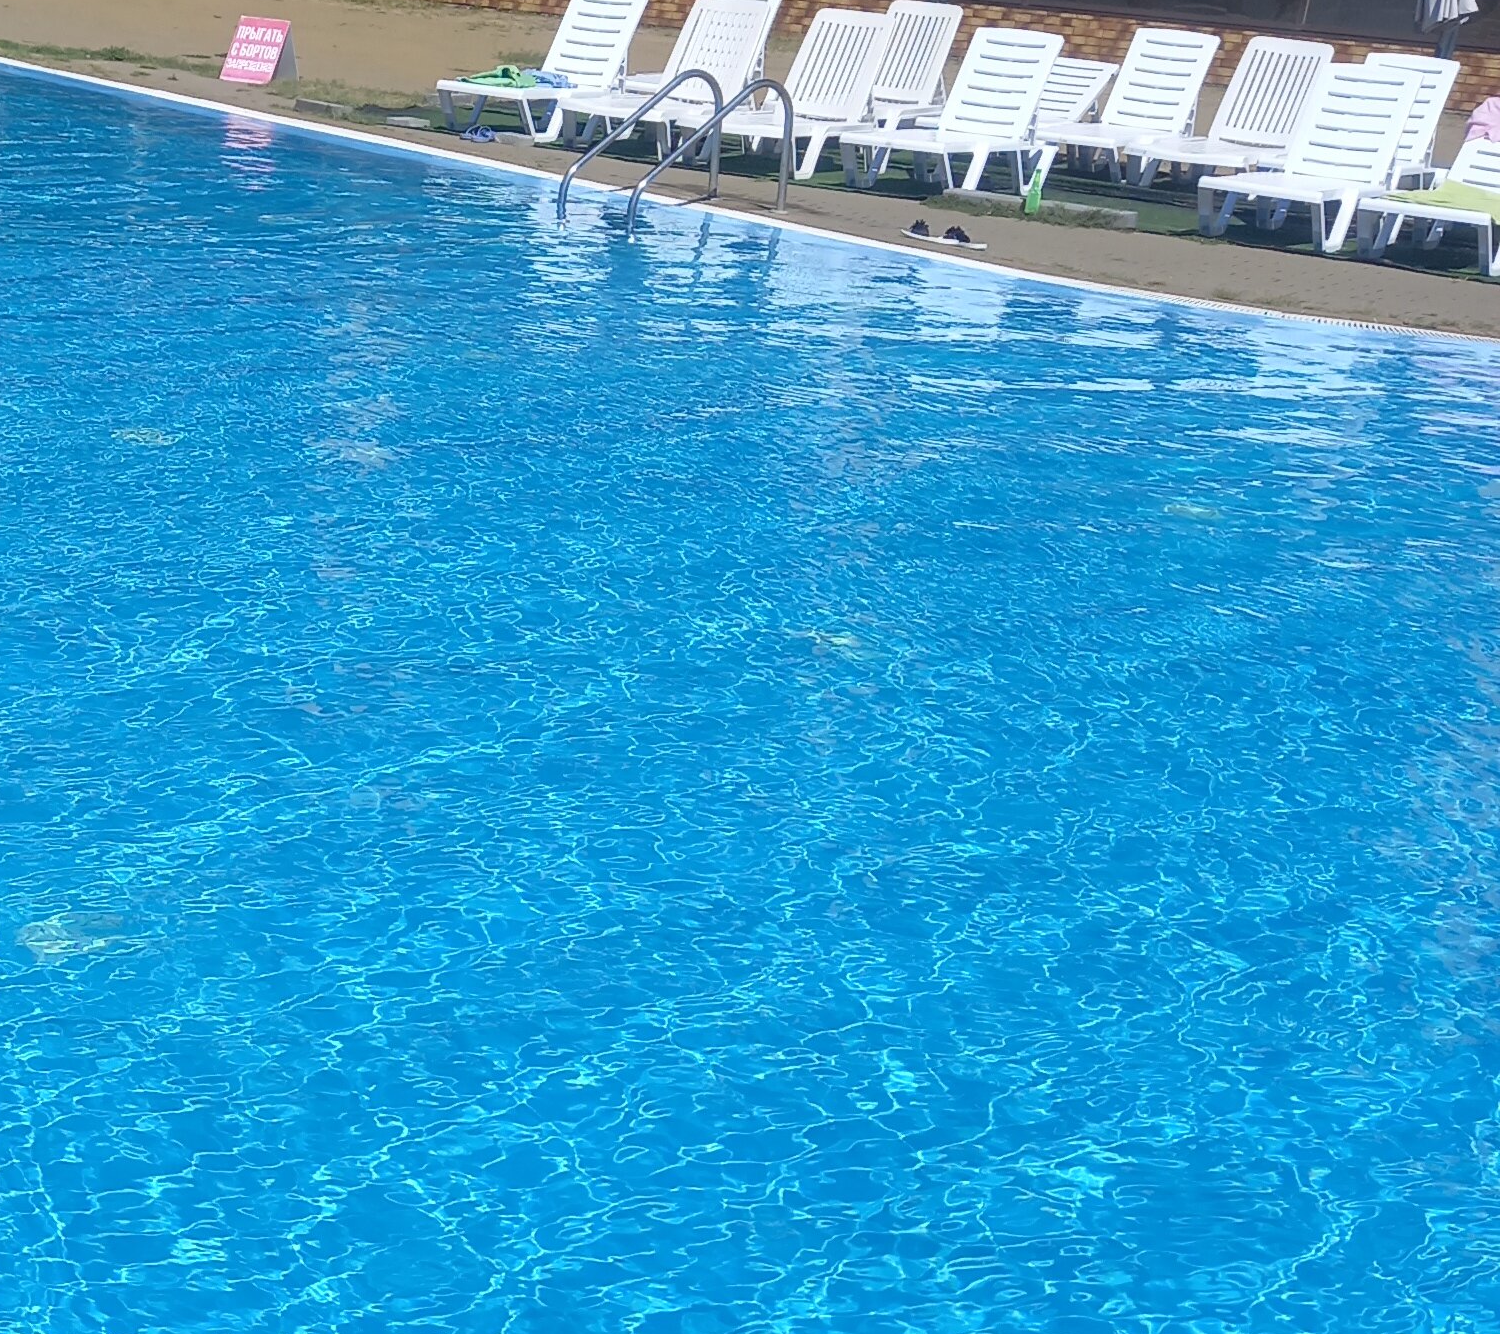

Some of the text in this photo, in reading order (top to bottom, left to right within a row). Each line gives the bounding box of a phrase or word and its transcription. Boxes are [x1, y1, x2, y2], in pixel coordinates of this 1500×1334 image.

[236, 25, 284, 43] ПРЫГАТЬ
[231, 42, 278, 60] С БОРТОВ
